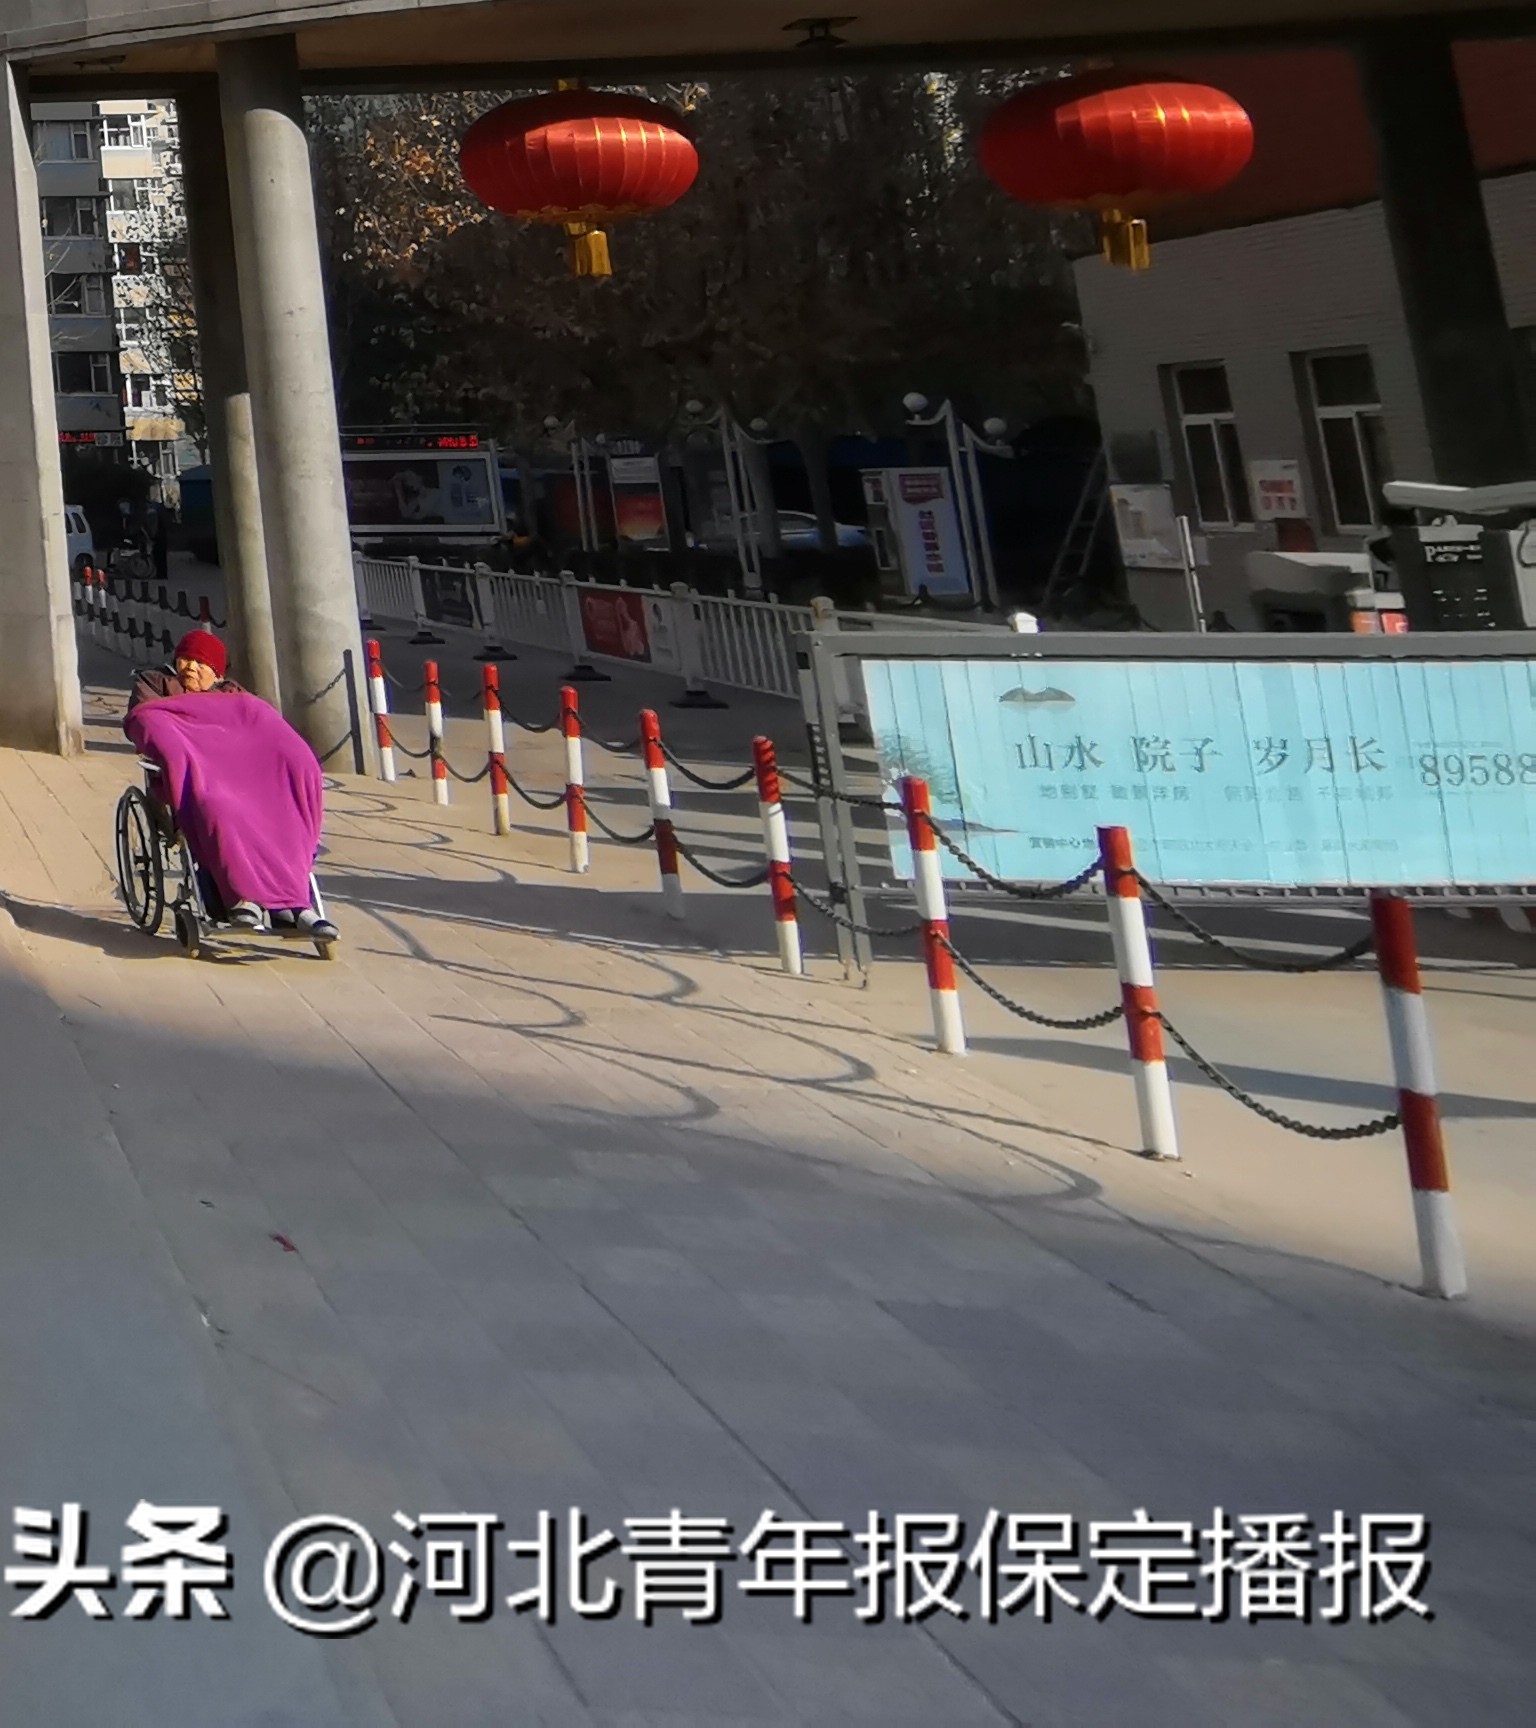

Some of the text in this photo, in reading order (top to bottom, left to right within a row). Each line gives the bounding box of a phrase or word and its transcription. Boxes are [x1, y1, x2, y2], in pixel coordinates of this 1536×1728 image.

[1015, 732, 1387, 775] 山水 院子 岁月长
